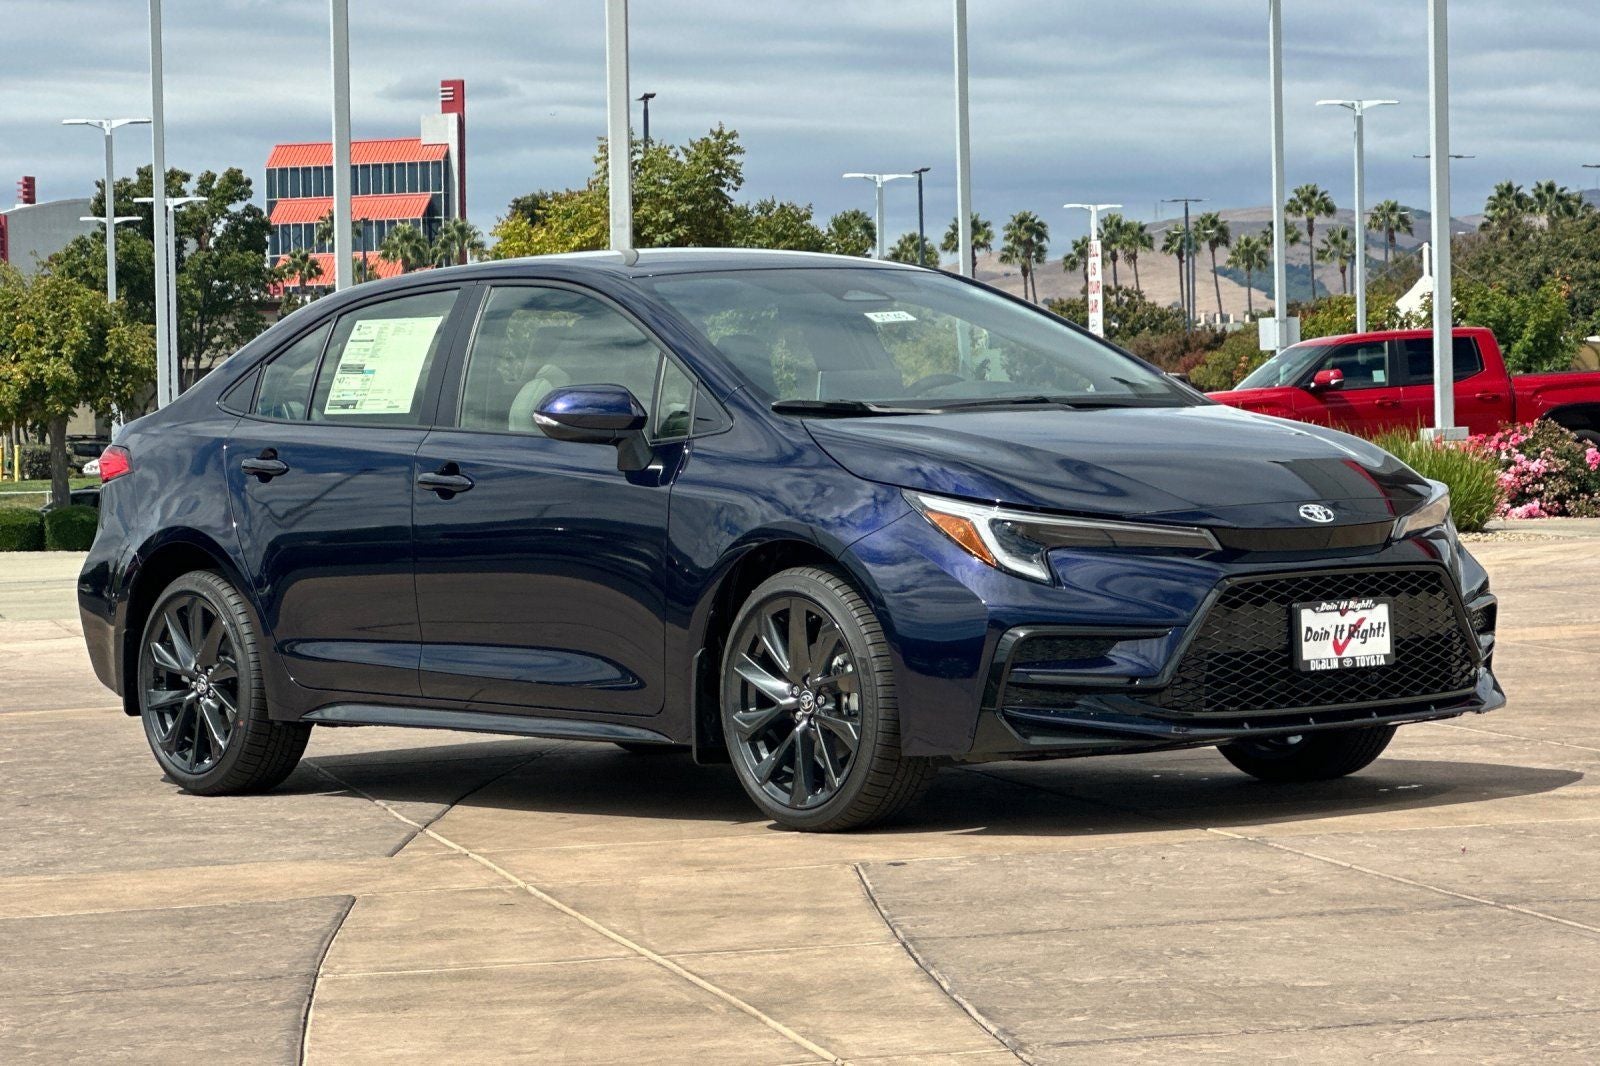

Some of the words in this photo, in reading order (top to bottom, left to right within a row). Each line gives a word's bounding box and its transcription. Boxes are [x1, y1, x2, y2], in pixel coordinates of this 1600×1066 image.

[1340, 601, 1347, 610] It
[1348, 600, 1372, 612] Right!
[1304, 624, 1332, 642] Doin'
[1333, 624, 1345, 640] It
[1347, 621, 1386, 644] Right!
[1310, 658, 1339, 671] DUBLIN
[1355, 654, 1385, 667] TOYOTA
